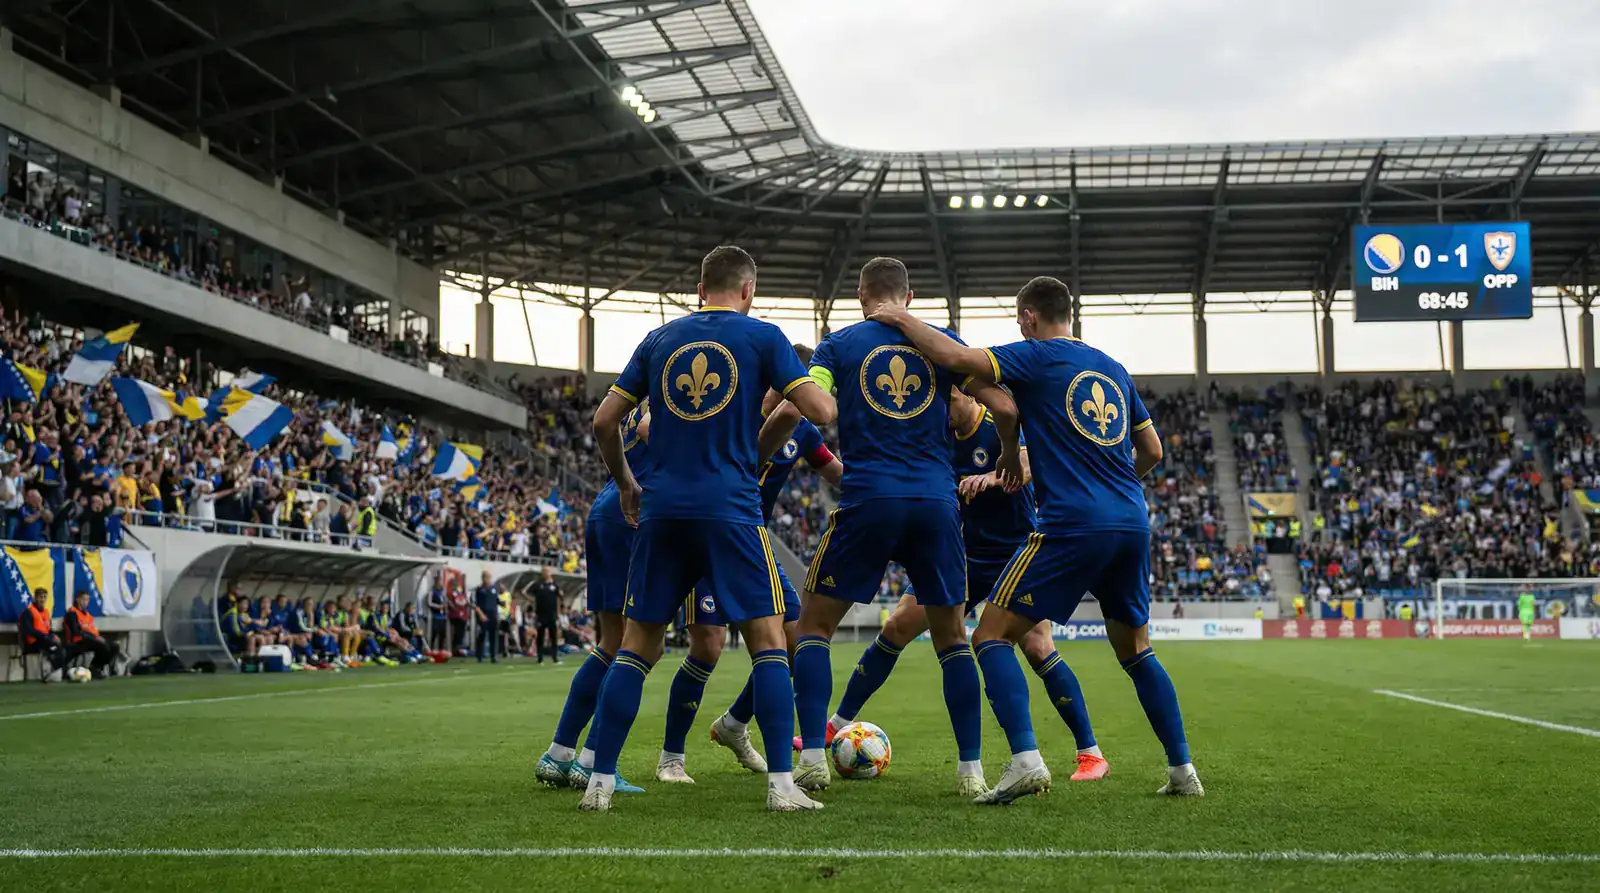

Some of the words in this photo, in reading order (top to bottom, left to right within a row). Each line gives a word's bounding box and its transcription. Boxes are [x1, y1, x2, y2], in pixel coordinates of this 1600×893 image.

[1414, 245, 1430, 268] 0
[1437, 254, 1449, 263] -
[1454, 244, 1468, 268] 1
[1371, 277, 1399, 291] BIH
[1483, 274, 1518, 289] OPP
[1418, 292, 1469, 309] 68:45
